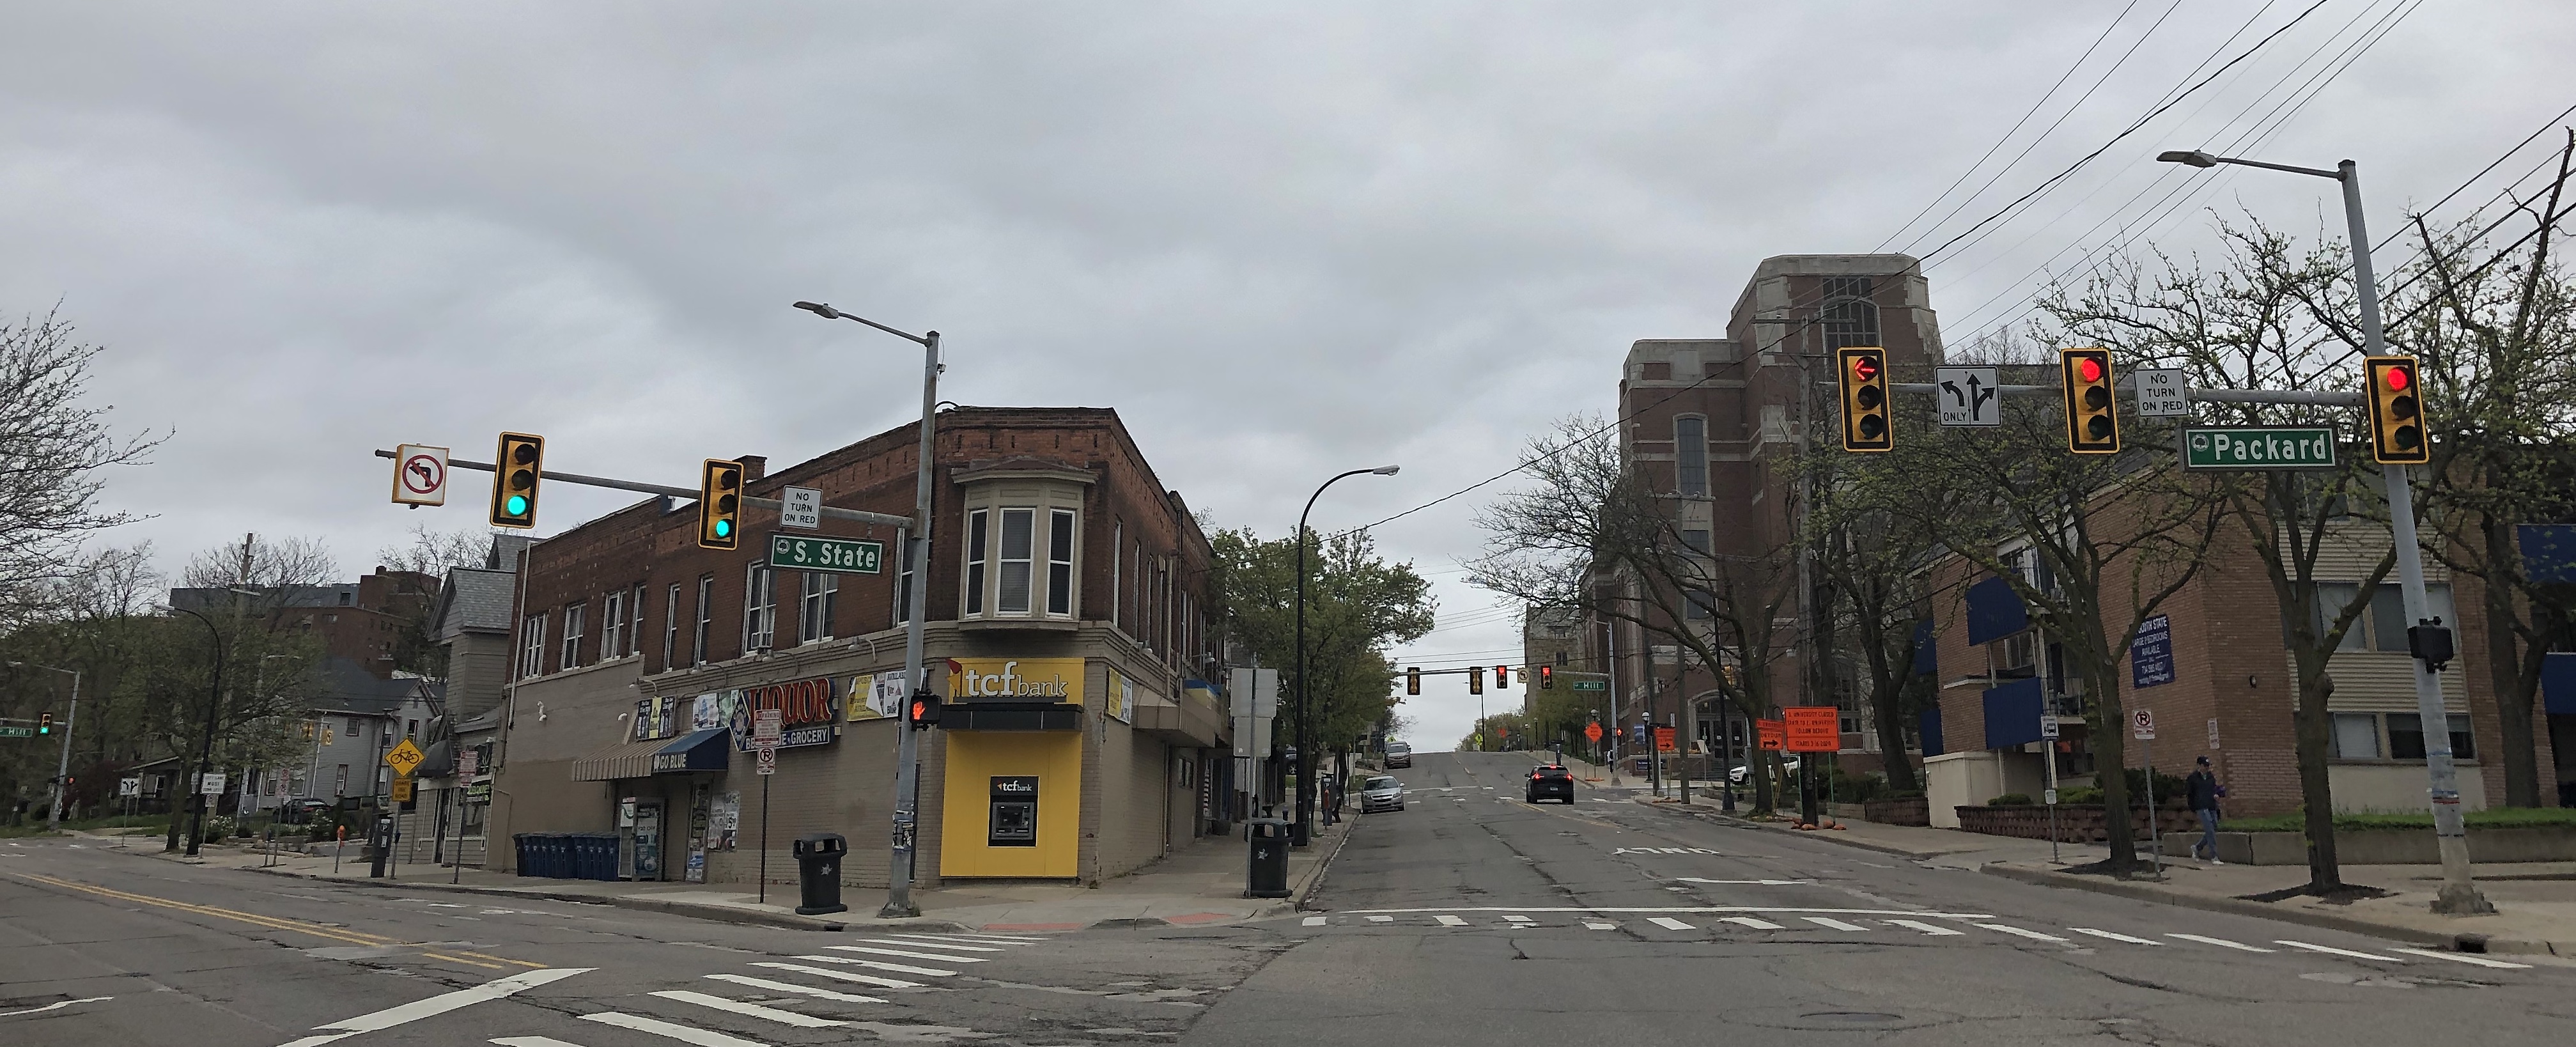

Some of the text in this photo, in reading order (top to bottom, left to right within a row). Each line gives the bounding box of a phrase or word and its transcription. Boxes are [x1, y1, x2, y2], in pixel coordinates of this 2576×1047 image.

[2150, 375, 2168, 384] NO
[2146, 388, 2175, 398] TURN
[2143, 401, 2183, 411] ON RED
[1943, 412, 1966, 421] ONLY
[2214, 433, 2326, 461] Packard
[796, 492, 809, 501] NO
[791, 503, 812, 512] TURN
[784, 513, 816, 524] ON RED
[793, 541, 875, 568] S. State
[2153, 616, 2168, 630] STATE
[749, 678, 832, 729] LIQUOR
[791, 729, 827, 745] GROCERY
[660, 754, 687, 770] GO BLUE
